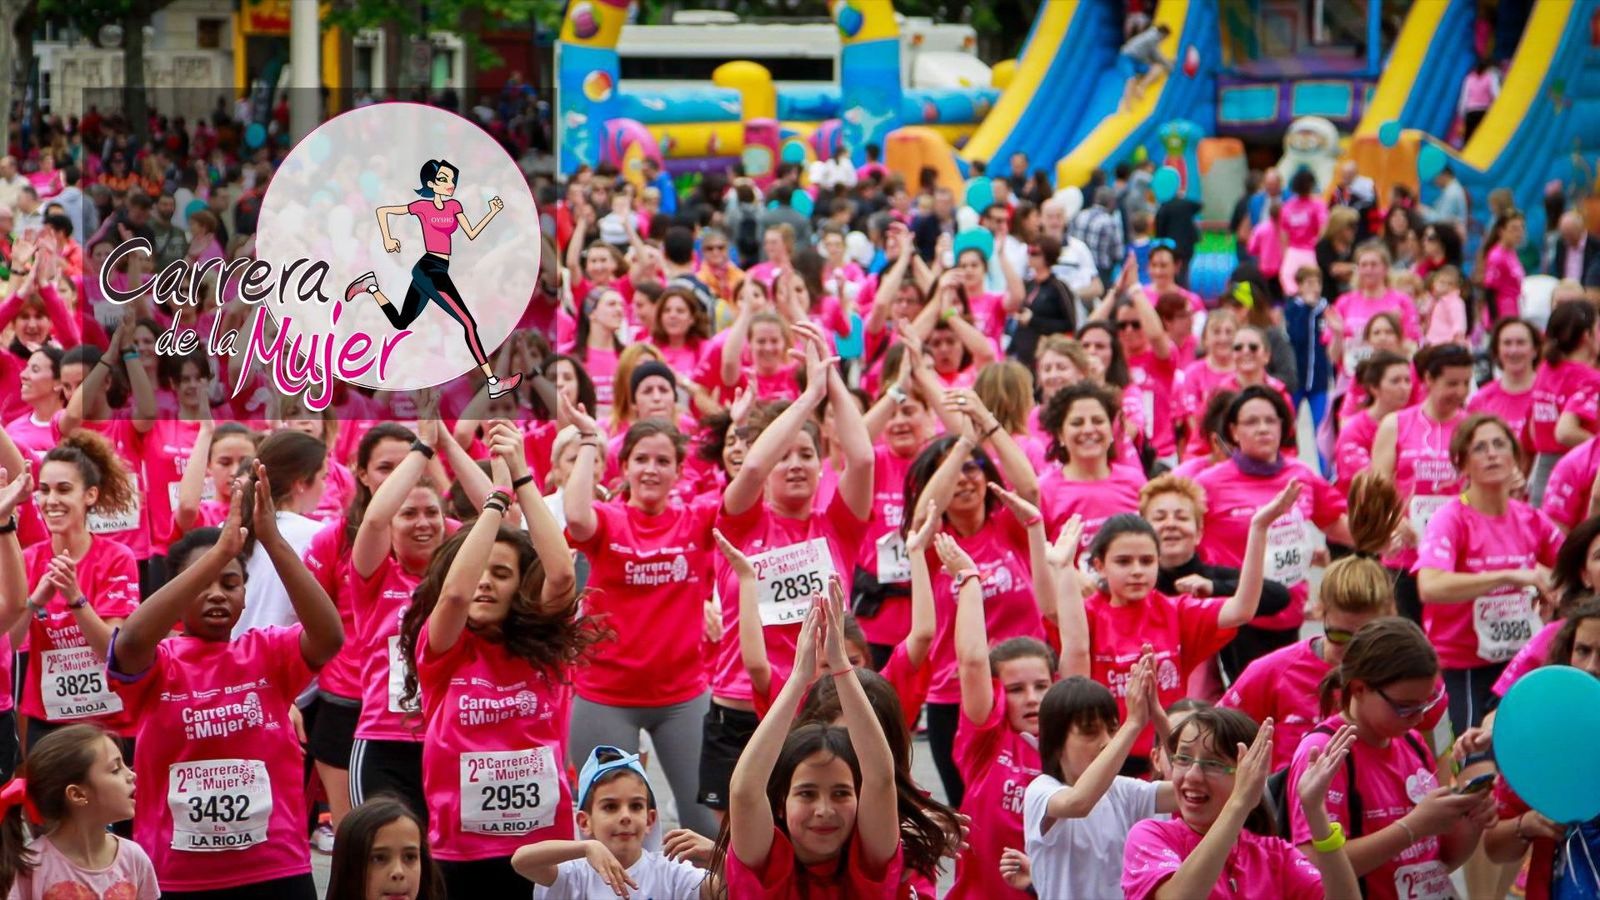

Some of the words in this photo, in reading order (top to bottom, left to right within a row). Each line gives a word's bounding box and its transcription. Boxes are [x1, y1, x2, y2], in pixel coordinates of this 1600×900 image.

[769, 548, 807, 566] Carrera
[625, 561, 672, 573] Carrera
[778, 558, 808, 574] Mujer
[633, 572, 672, 586] Mujer
[771, 571, 824, 603] 2835
[778, 611, 794, 621] LA
[46, 625, 80, 638] Carrer
[57, 650, 91, 662] Carrera
[63, 660, 92, 672] Mujer
[56, 672, 102, 697] 3825
[60, 706, 73, 715] LA
[76, 702, 107, 713] RIOJA
[459, 695, 516, 710] Carrera
[182, 703, 243, 723] Carrera
[469, 708, 516, 725] Mujer
[195, 717, 244, 739] Mujer
[486, 755, 530, 770] Carrera
[194, 764, 239, 779] Carrera
[495, 767, 530, 781] Mujer
[203, 776, 239, 791] Mujer
[481, 782, 540, 811] 2953
[188, 794, 250, 823] 3432
[482, 822, 499, 831] LA
[503, 820, 539, 831] RIOJA
[192, 835, 209, 846] LA
[213, 832, 253, 846] RIOJA
